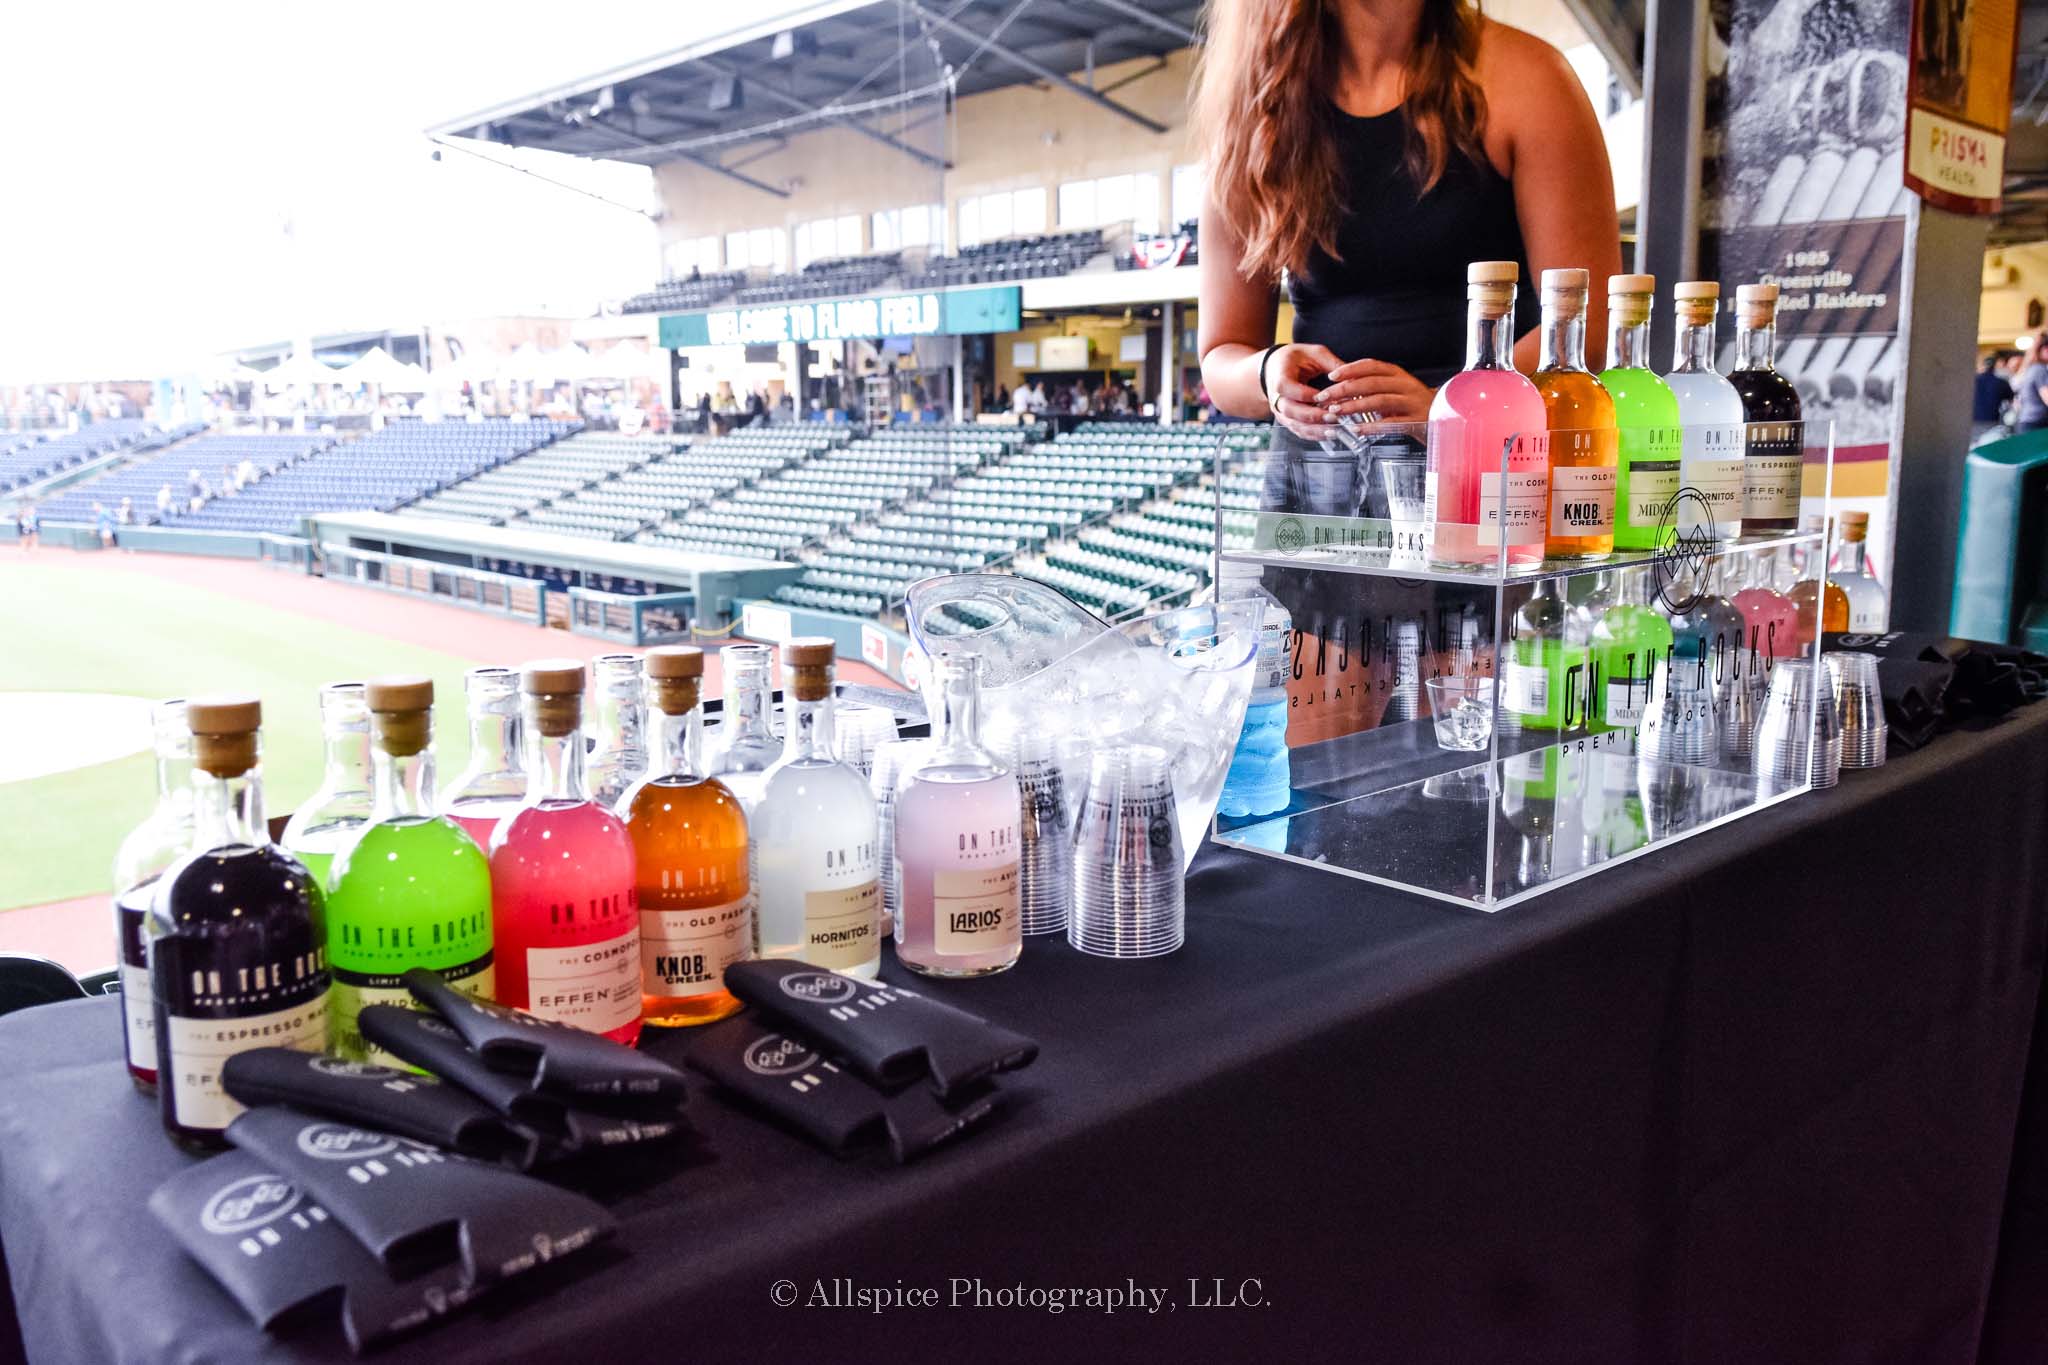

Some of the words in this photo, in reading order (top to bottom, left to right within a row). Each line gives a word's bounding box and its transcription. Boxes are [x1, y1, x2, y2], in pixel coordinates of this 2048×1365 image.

[1930, 126, 1987, 168] PRISMA
[1814, 291, 1887, 311] Raiders
[706, 310, 788, 344] WELCOME
[788, 304, 814, 340] TO
[880, 295, 939, 336] FIELD
[1574, 433, 1591, 449] ON
[1649, 430, 1664, 444] ON
[1706, 430, 1721, 445] ON
[1752, 427, 1768, 442] ON
[1777, 426, 1795, 441] THE
[1591, 473, 1608, 481] OLD
[1690, 492, 1735, 501] HORNITOS
[1564, 503, 1599, 520] KNOB
[1314, 526, 1330, 544] ON
[1341, 528, 1365, 547] THE
[1377, 530, 1424, 551] ROCKS
[1564, 660, 1599, 726] ON
[1626, 644, 1675, 709] THE
[1562, 720, 1656, 758] PREMIUM
[1673, 687, 1771, 726] COCKTAILS
[959, 832, 978, 850] ON
[991, 826, 1012, 848] THE
[827, 849, 845, 869] ON
[662, 869, 684, 890] ON
[552, 904, 574, 925] ON
[690, 916, 716, 927] OLD
[950, 907, 1002, 934] LARIOS
[343, 924, 362, 946] ON
[377, 926, 414, 948] THE
[433, 911, 485, 944] ROCKS
[811, 924, 869, 944] HORNITOS
[656, 954, 704, 977] KNOB
[665, 972, 713, 985] CREEK
[540, 988, 608, 1007] EFFEN
[217, 1018, 302, 1042] ESPRESSO
